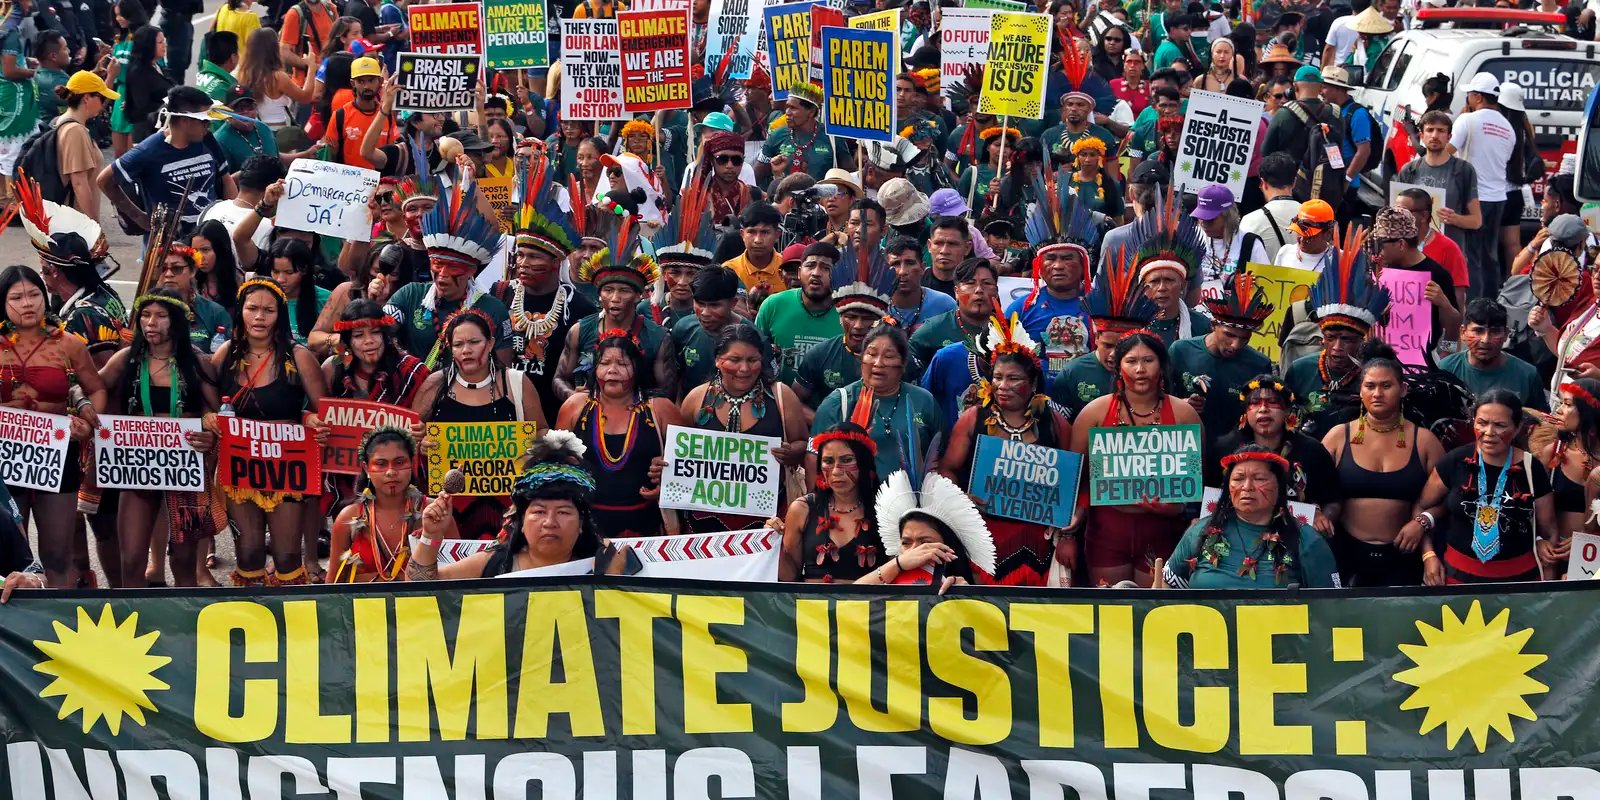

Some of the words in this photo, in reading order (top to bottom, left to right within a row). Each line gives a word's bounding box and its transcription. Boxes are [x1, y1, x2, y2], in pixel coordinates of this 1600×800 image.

[411, 11, 478, 30] CLIMATE
[487, 17, 524, 34] LIVRE
[526, 16, 544, 31] DE
[565, 22, 591, 34] THEY
[620, 17, 686, 38] CLIMATE
[718, 16, 749, 34] SOBRE
[877, 16, 890, 28] THE
[413, 30, 478, 44] EMERGENCY
[566, 36, 591, 49] OUR
[622, 35, 686, 50] EMERGENCY
[944, 30, 952, 42] O
[584, 52, 608, 63] NOW
[625, 52, 650, 70] WE
[654, 49, 684, 68] ARE
[776, 39, 796, 64] DE
[830, 38, 888, 70] PAREM
[969, 45, 974, 57] É
[988, 42, 1045, 64] NATURE
[414, 59, 464, 76] BRASIL
[566, 64, 593, 75] THEY
[646, 71, 664, 83] THE
[1005, 63, 1039, 72] ANSWER
[406, 74, 447, 92] LIVRE
[449, 76, 468, 91] DE
[572, 76, 585, 87] TO
[588, 76, 620, 87] STEAL
[831, 68, 851, 97] DE
[854, 70, 887, 100] NOS
[990, 69, 1006, 91] IS
[1008, 71, 1034, 94] US
[1504, 68, 1595, 88] POLÍCIA
[584, 89, 609, 102] OUR
[626, 83, 688, 103] ANSWER
[570, 104, 622, 117] HISTORY
[829, 97, 890, 133] MATAR!
[1218, 109, 1228, 124] A
[1187, 119, 1251, 145] RESPOSTA
[1183, 135, 1249, 165] SOMOS
[113, 419, 181, 433] EMERGÊNCIA
[229, 418, 239, 436] O
[242, 419, 306, 442] FUTURO
[446, 426, 494, 442] CLIMA
[497, 425, 517, 441] DE
[251, 439, 260, 457] É
[261, 442, 282, 458] DO
[674, 432, 768, 464] SEMPRE
[1092, 428, 1198, 454] AMAZÔNIA
[99, 447, 111, 464] A
[114, 448, 200, 467] RESPOSTA
[1001, 440, 1058, 467] NOSSO
[231, 456, 307, 491] POVO
[463, 460, 516, 476] AGORA
[674, 458, 768, 484] ESTIVEMOS
[993, 458, 1059, 486] FUTURO
[1103, 454, 1158, 477] LIVRE
[1161, 454, 1188, 476] DE
[99, 465, 161, 486] SOMOS
[469, 476, 522, 493] AGOR
[690, 479, 747, 508] AQUI
[1096, 474, 1196, 500] PETRÓLEO
[1000, 497, 1053, 524] VENDA
[1583, 543, 1597, 562] O
[194, 590, 754, 744] CLIMATE
[781, 599, 1366, 756] JUSTICE:
